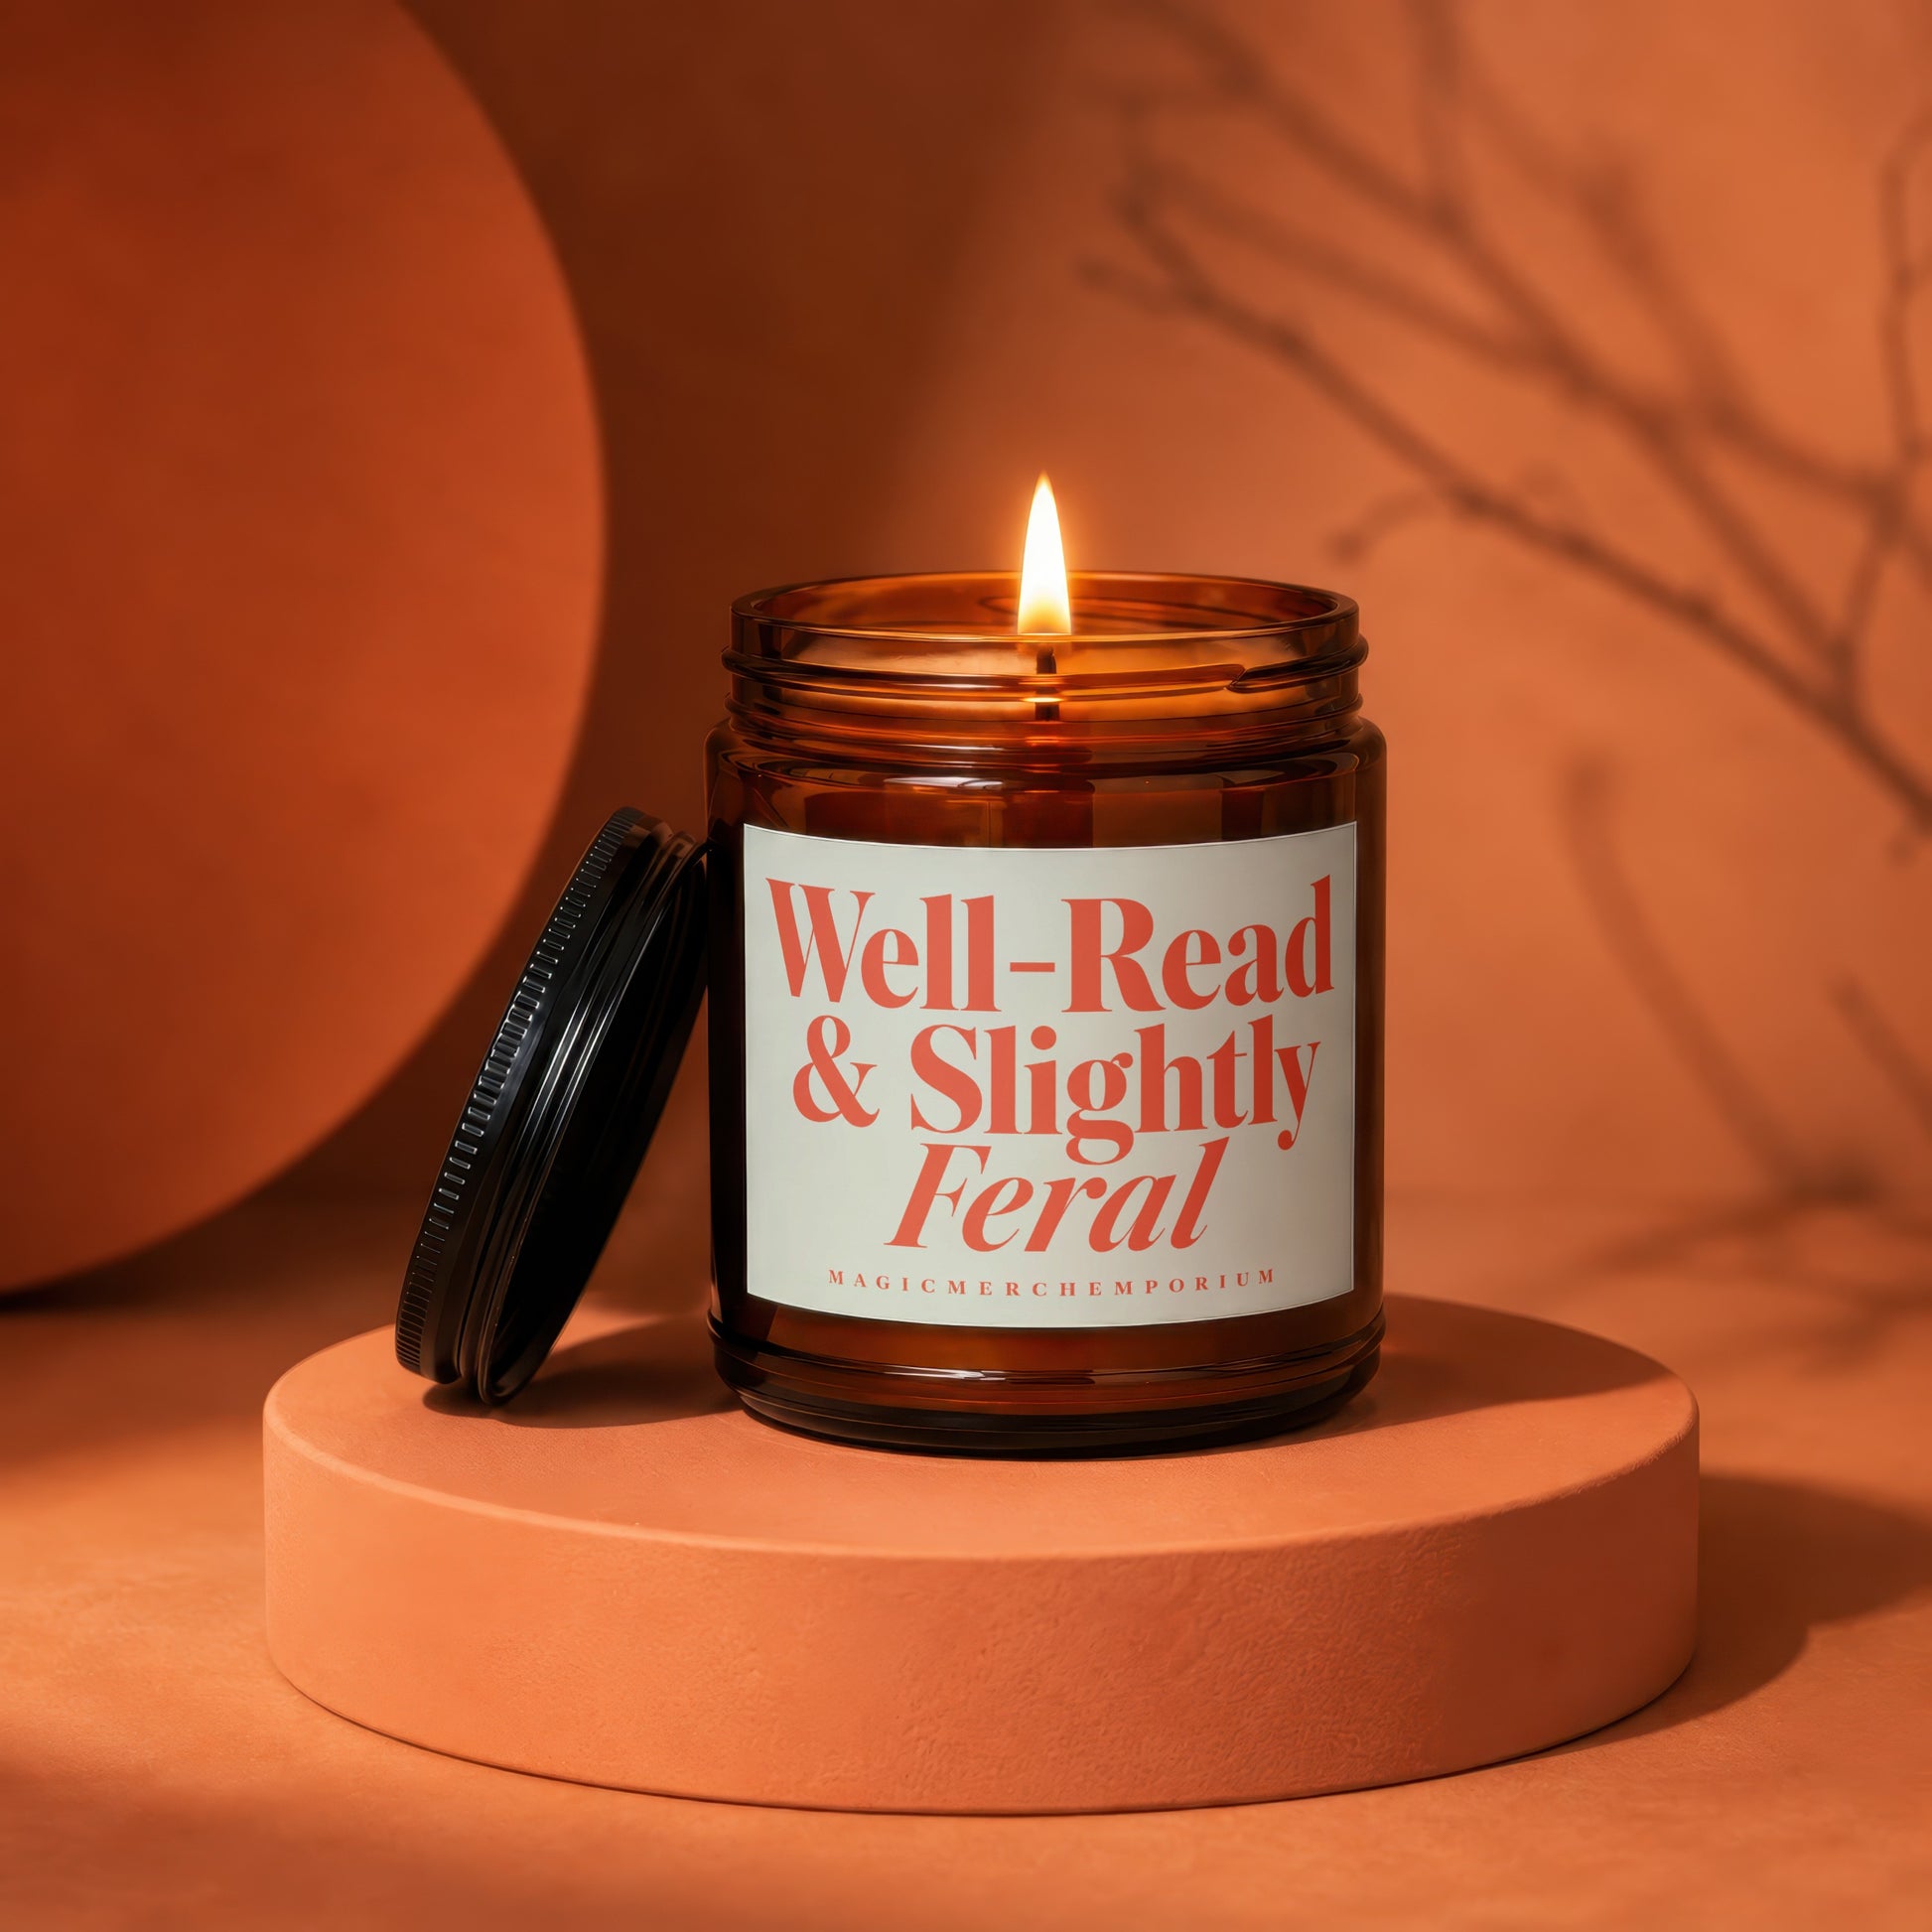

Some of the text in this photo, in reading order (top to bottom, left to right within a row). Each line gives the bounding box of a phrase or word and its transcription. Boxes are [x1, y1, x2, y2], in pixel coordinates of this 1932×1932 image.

[765, 875, 1334, 1013] Well-Read
[792, 1014, 1321, 1167] & Slightly
[884, 1136, 1230, 1254] Feral
[828, 1268, 1277, 1298] MAGICMERCHEMPORIUM
